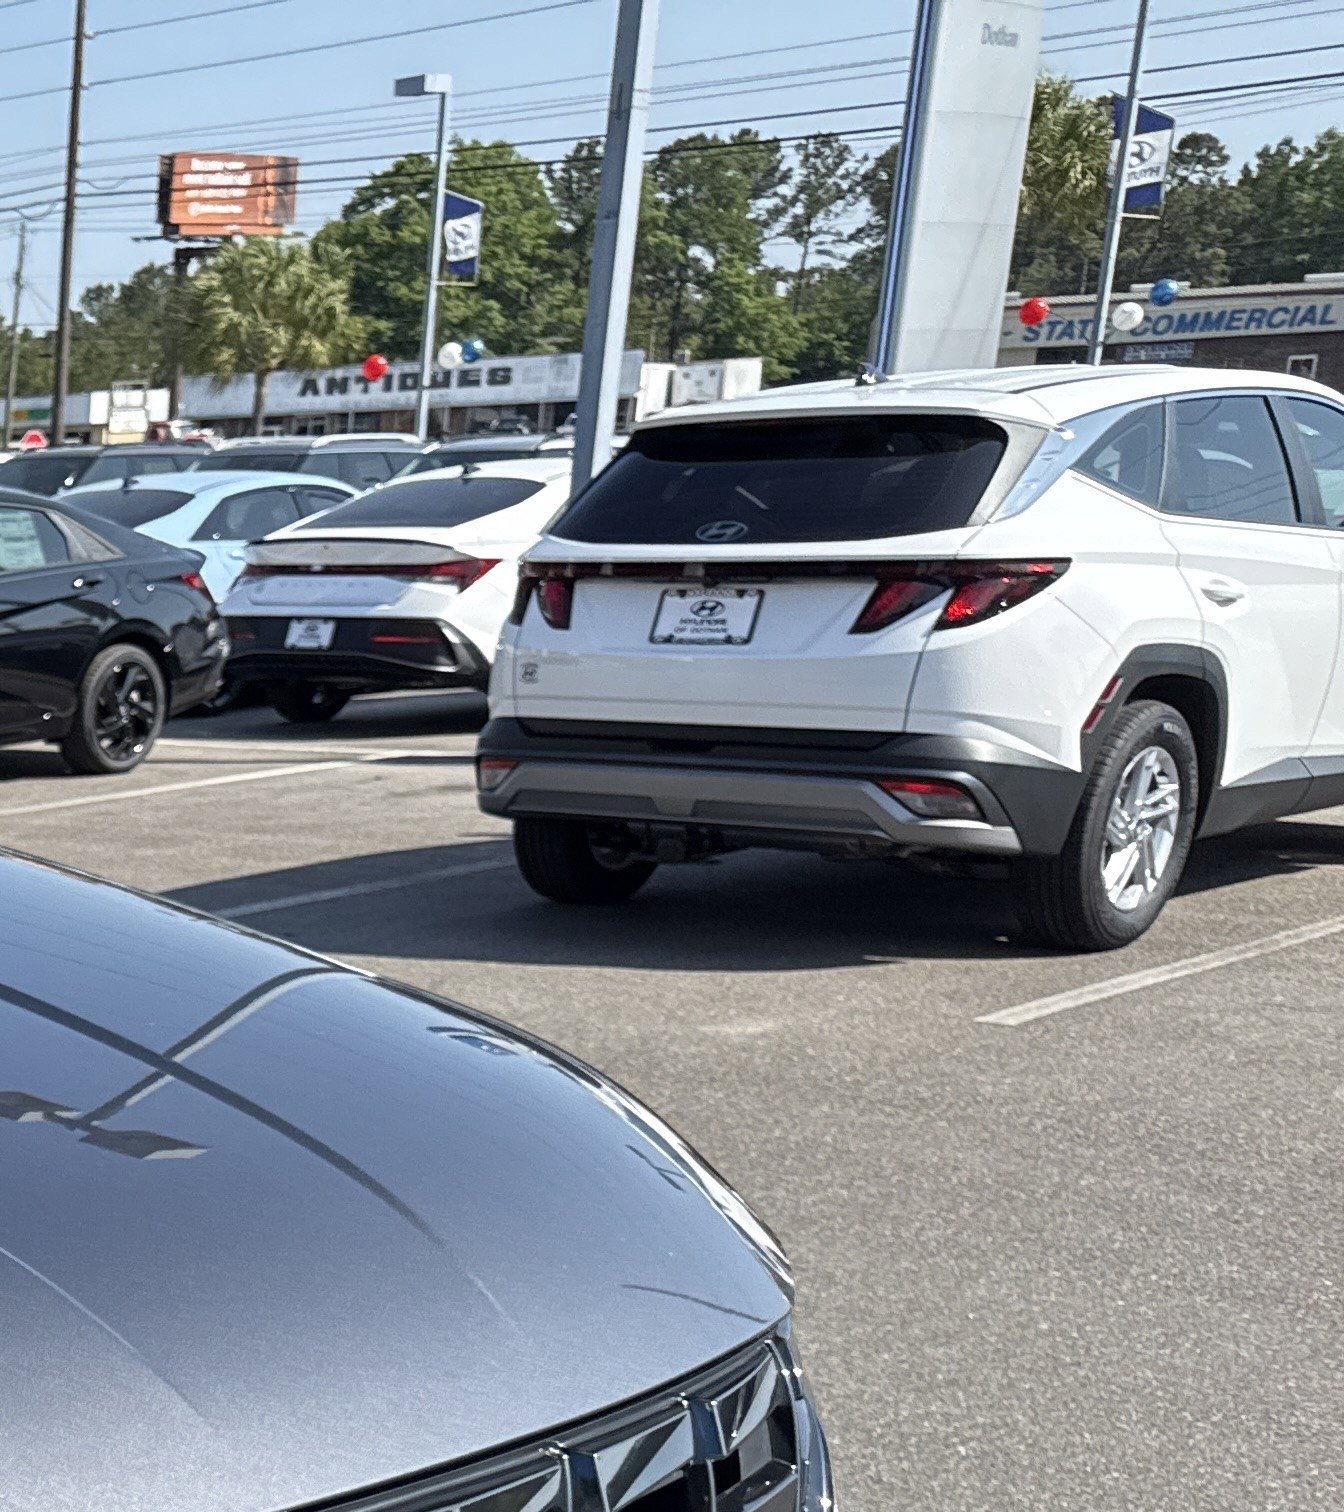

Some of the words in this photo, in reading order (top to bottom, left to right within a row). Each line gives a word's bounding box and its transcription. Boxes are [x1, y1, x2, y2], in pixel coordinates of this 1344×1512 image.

[1023, 317, 1110, 342] STAT
[1129, 303, 1337, 337] COMMERCIAL
[297, 366, 512, 397] ANTIQUES
